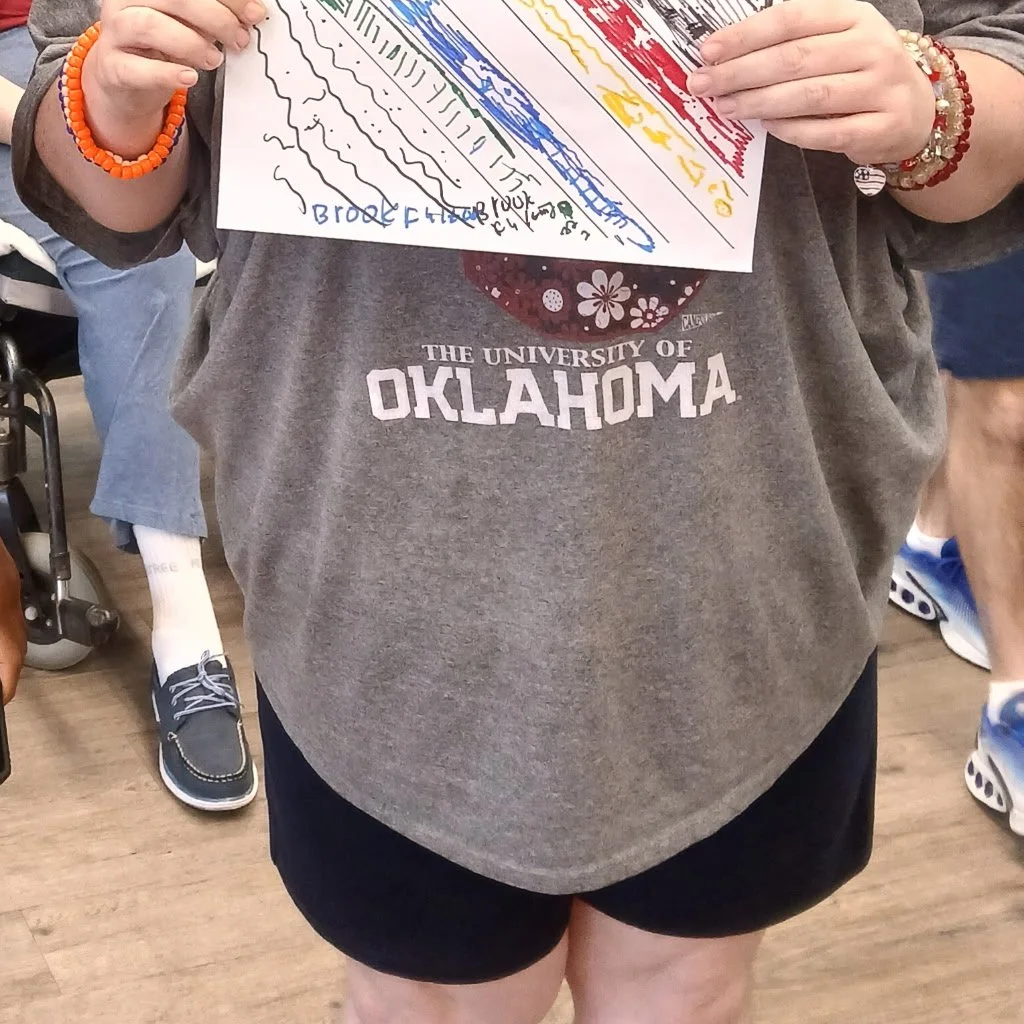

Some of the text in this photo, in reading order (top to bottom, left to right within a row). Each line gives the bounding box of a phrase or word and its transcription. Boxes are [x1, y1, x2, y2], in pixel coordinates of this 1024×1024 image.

[421, 339, 693, 369] THE UNIVERSITY OF
[366, 352, 738, 431] OKLAHOMA
